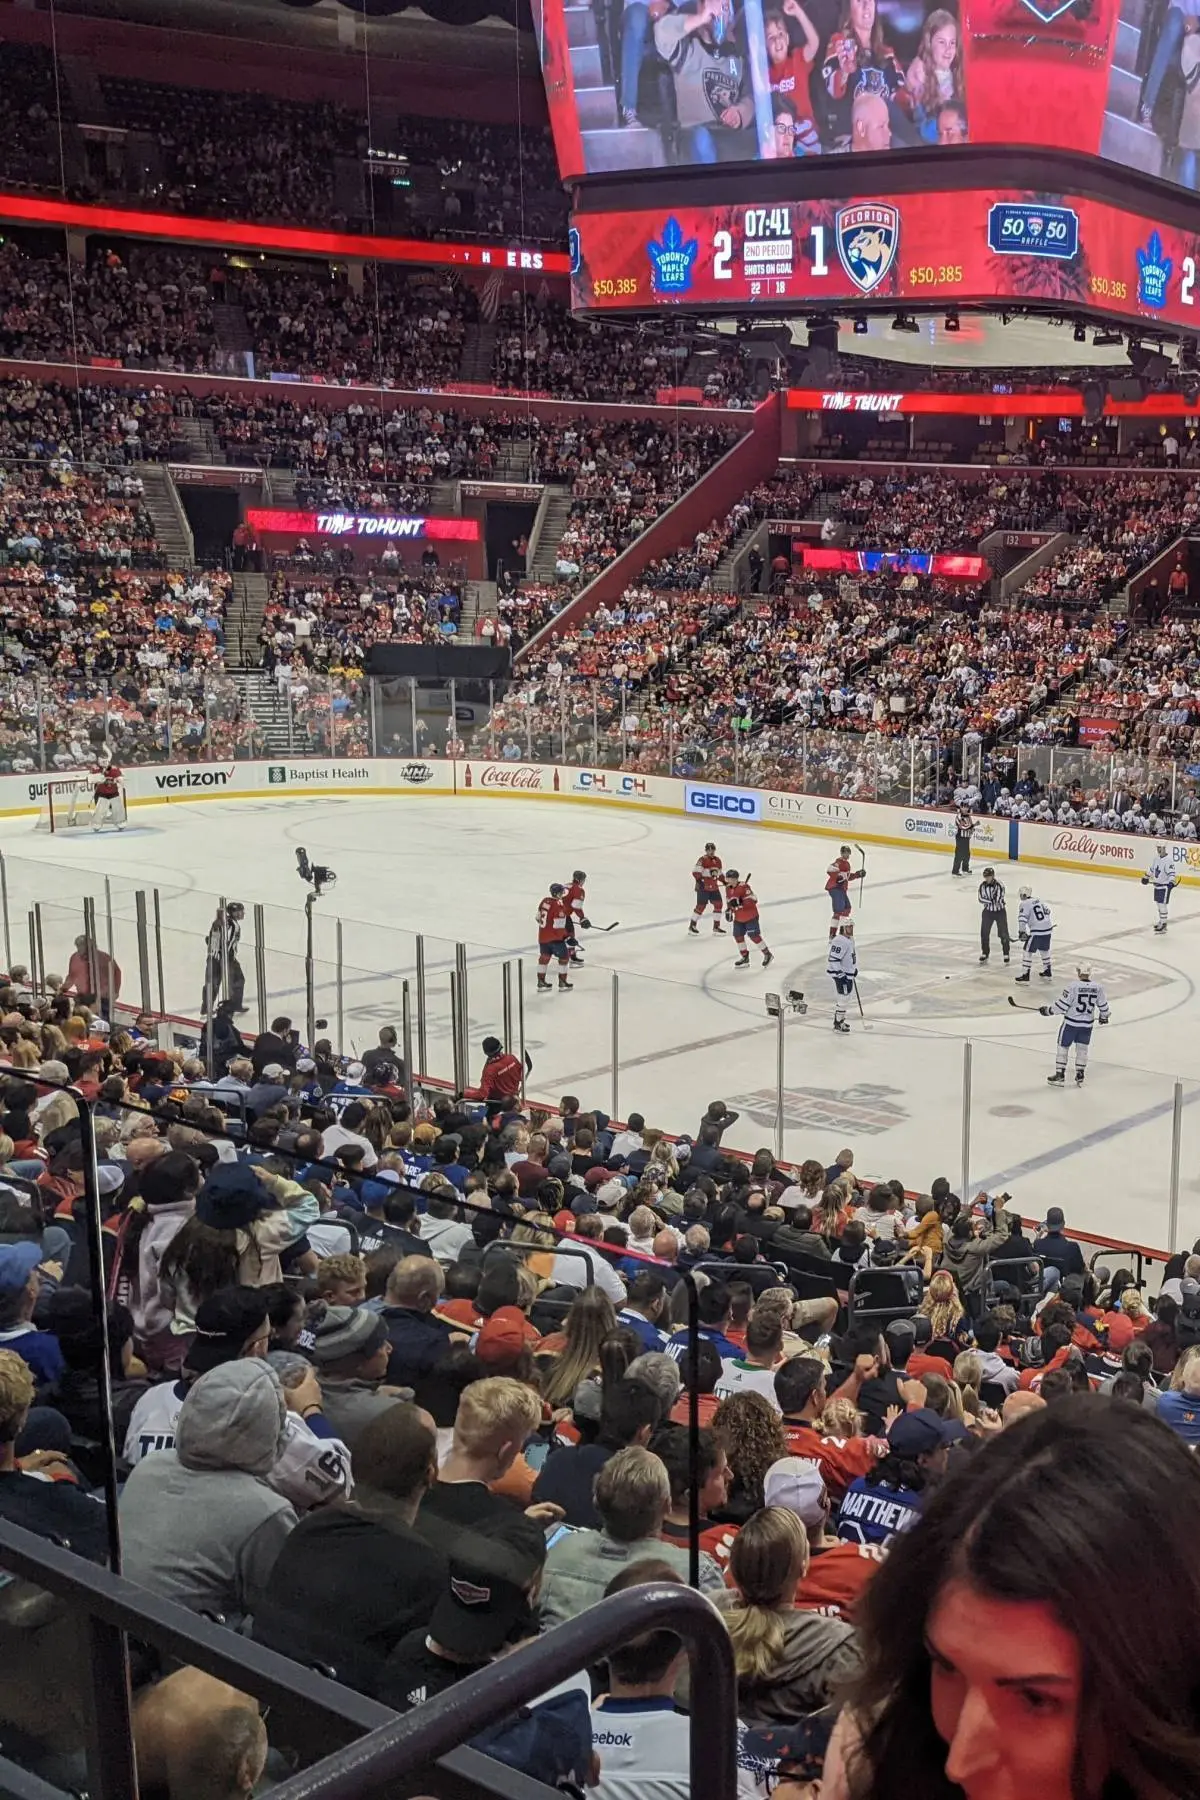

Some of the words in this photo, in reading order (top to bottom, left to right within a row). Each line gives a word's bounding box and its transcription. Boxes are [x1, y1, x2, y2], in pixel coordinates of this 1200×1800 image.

[744, 208, 792, 237] 07:41
[844, 211, 890, 227] FLORIDA
[1001, 218, 1025, 236] 50
[1045, 221, 1067, 240] 50
[1021, 237, 1049, 246] RAFFLE
[713, 230, 732, 280] 2
[745, 245, 760, 257] 2ND
[762, 243, 790, 257] PERIOD
[810, 226, 828, 276] 1
[655, 251, 690, 266] TORONTO
[661, 263, 685, 274] MAPLE
[744, 264, 764, 276] SHOTS
[776, 262, 792, 274] GOAL
[909, 266, 962, 286] $50,385
[1142, 265, 1166, 283] TORONTO
[661, 273, 685, 282] LEAFS
[1145, 276, 1163, 290] MAPLE
[1180, 256, 1195, 305] 2
[593, 279, 637, 297] $50,385
[751, 282, 761, 295] 22
[775, 281, 786, 294] 18
[1090, 276, 1127, 300] $50,385
[1144, 285, 1162, 297] LEAFS
[1006, 535, 1019, 545] 132
[155, 770, 227, 788] verizon
[290, 769, 328, 782] Baptist
[332, 767, 369, 779] Health
[691, 791, 756, 814] GEICO
[768, 796, 804, 812] CITY
[816, 803, 853, 818] CITY
[916, 819, 944, 829] BROWARD
[916, 826, 937, 834] HEALTH
[973, 832, 994, 842] Hospital
[1052, 831, 1098, 860] Bally
[1099, 843, 1135, 860] SPORTS
[831, 944, 842, 954] 88
[1075, 993, 1098, 1014] 55
[304, 1450, 343, 1485] 16
[839, 1491, 922, 1532] MATTHEW
[592, 1732, 633, 1747] eebok
